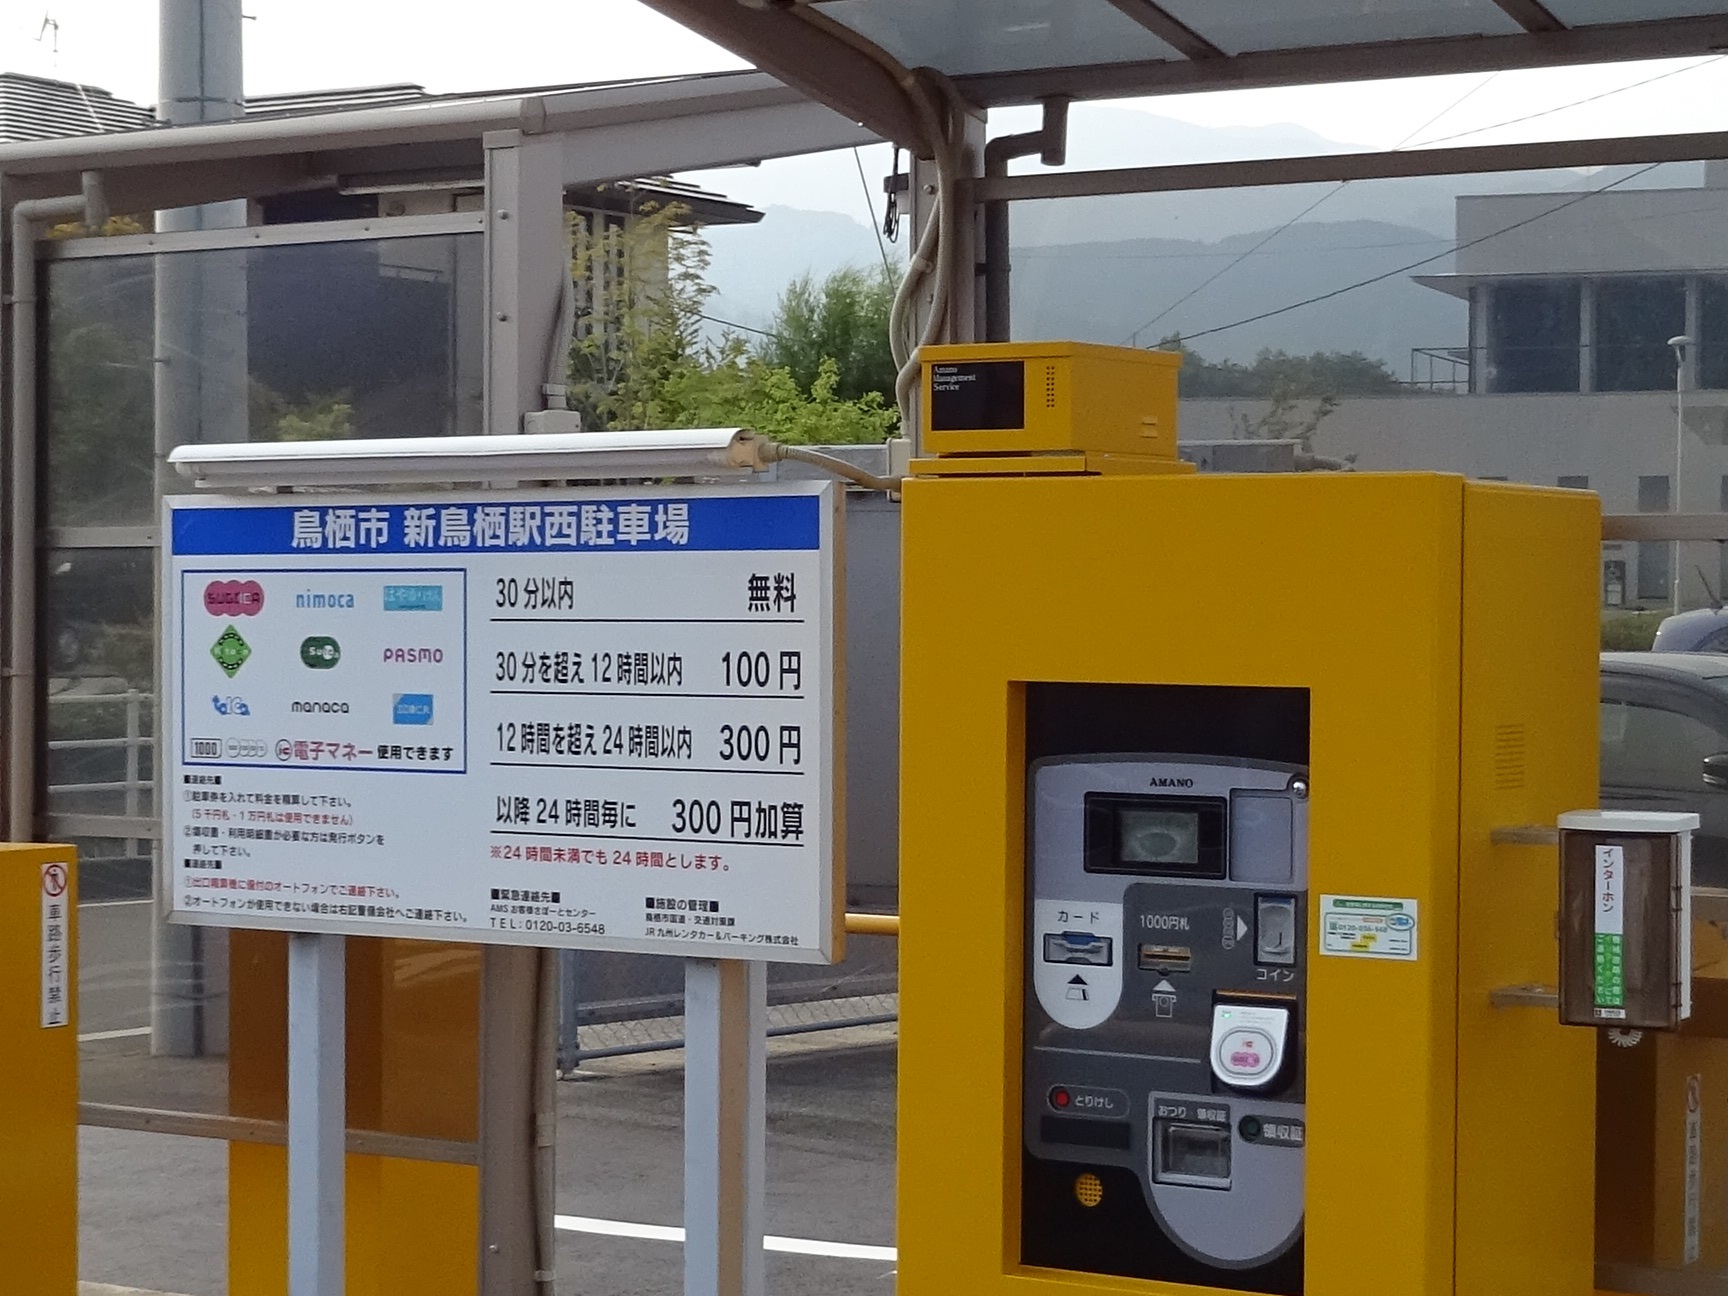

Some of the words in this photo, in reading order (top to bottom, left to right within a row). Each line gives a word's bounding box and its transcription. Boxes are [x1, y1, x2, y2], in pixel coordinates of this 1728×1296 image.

[934, 383, 960, 391] Service
[291, 508, 390, 549] 鳥栖市
[403, 504, 690, 548] 新鳥栖駅西駐車場
[295, 589, 355, 608] nimoca
[747, 573, 797, 613] 無料
[383, 648, 443, 663] PASMO
[291, 701, 350, 713] manaca
[194, 742, 217, 755] 1000
[293, 740, 373, 761] 電子マネー
[377, 745, 454, 761] 使用できます
[1149, 777, 1194, 789] AMANO
[1602, 848, 1615, 913] インターホン
[1057, 910, 1100, 924] カード
[1139, 914, 1190, 930] 1000円札
[1256, 968, 1295, 982] コイン
[1074, 1095, 1114, 1109] とりけし
